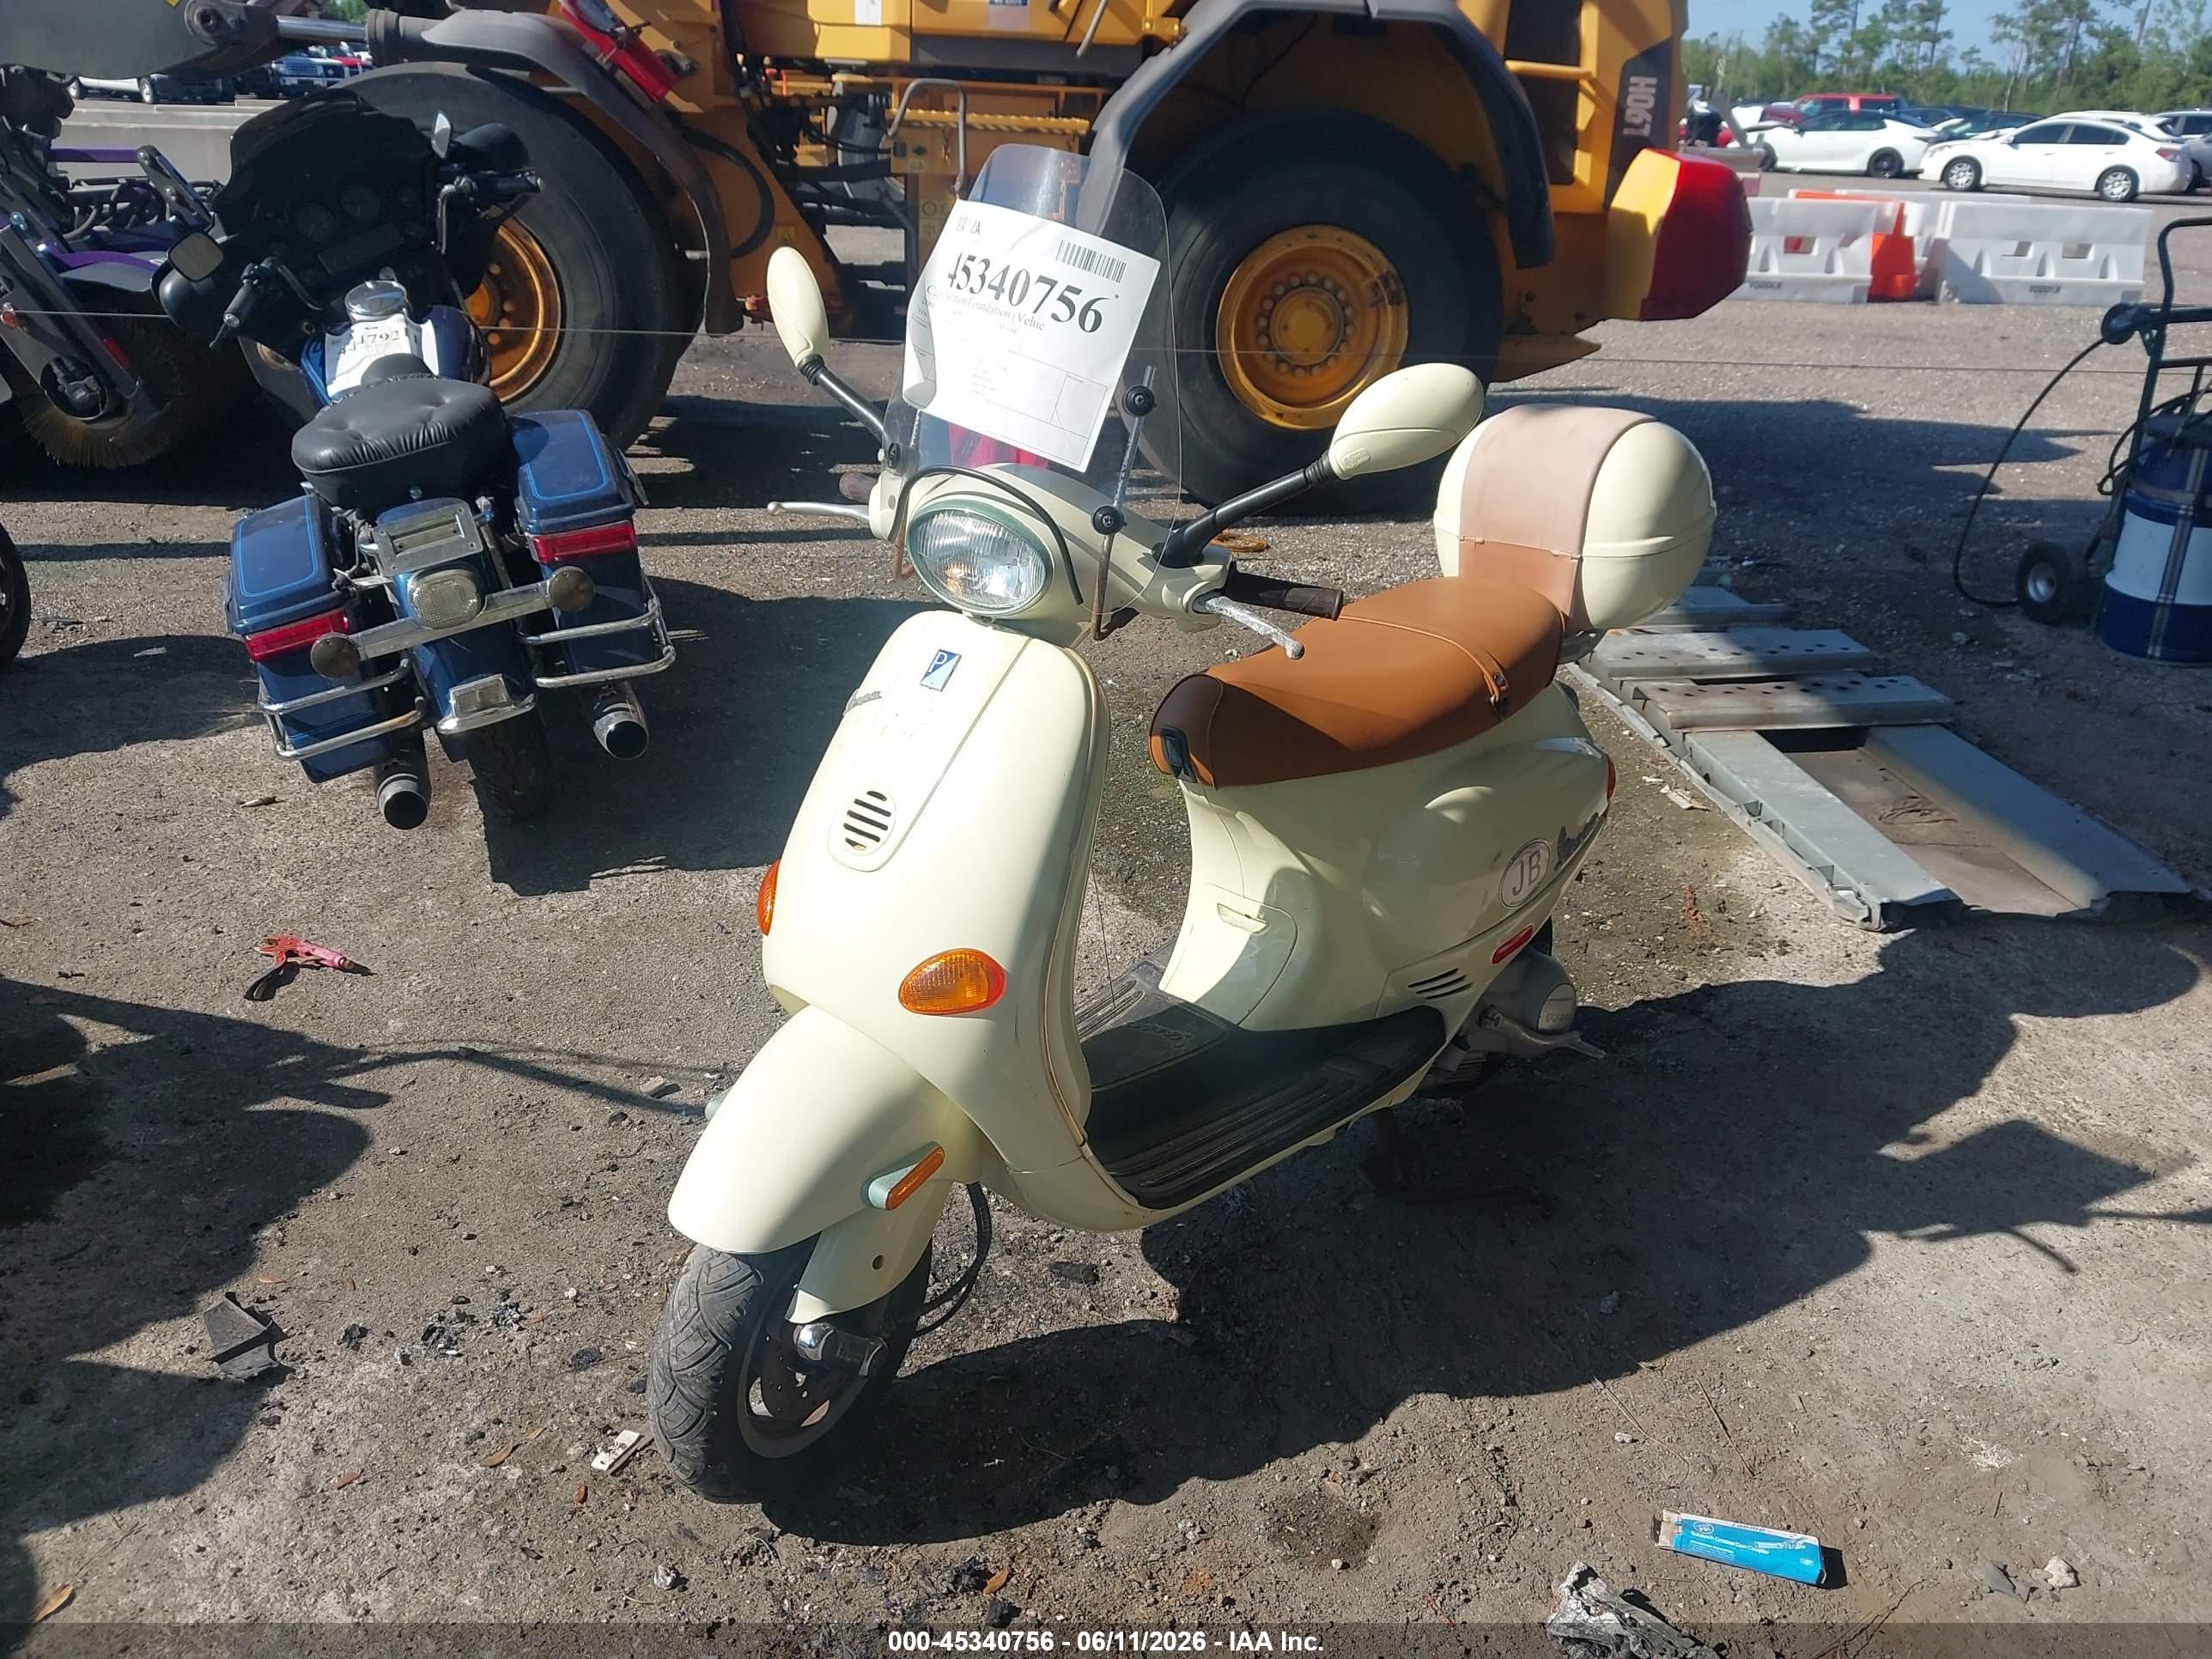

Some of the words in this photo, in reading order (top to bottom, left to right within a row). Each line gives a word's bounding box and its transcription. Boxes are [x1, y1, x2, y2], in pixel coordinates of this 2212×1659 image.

[1623, 76, 1658, 137] L90H
[947, 252, 1112, 333] 45340756
[1511, 850, 1541, 896] JB
